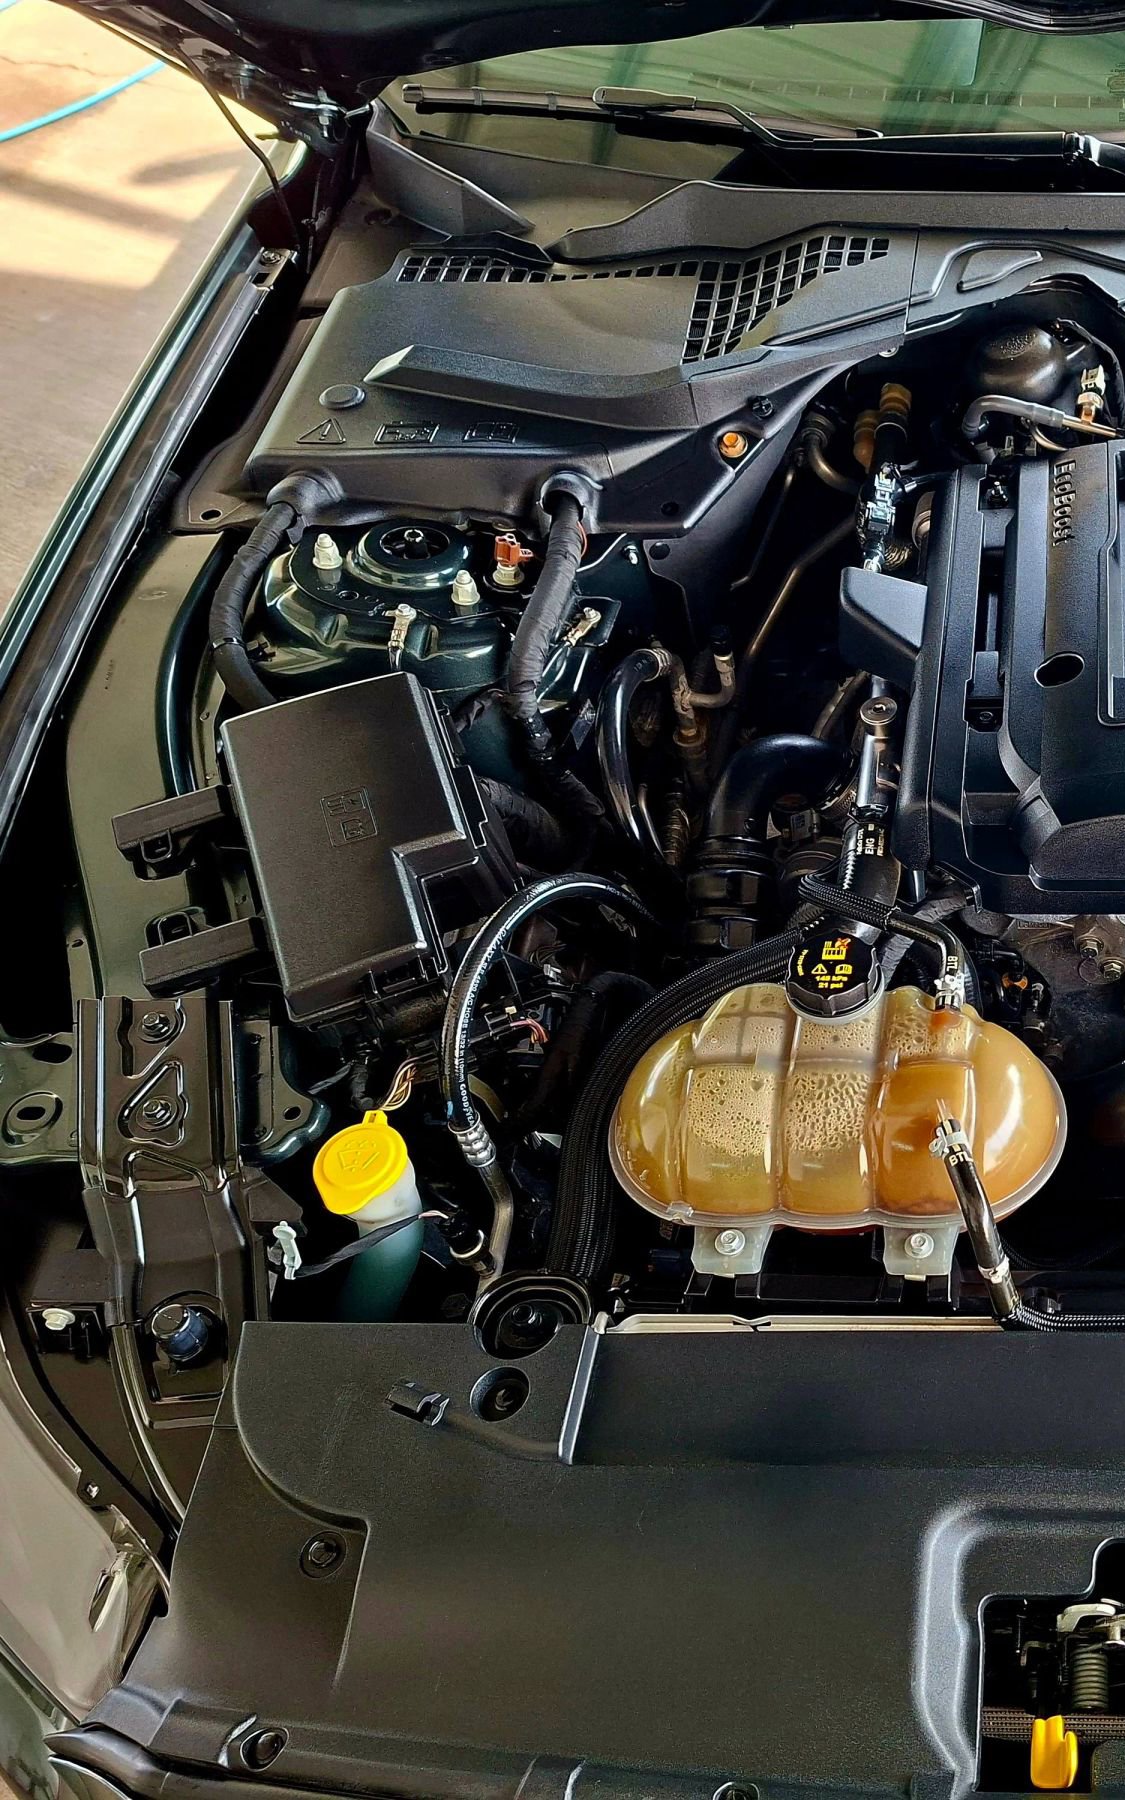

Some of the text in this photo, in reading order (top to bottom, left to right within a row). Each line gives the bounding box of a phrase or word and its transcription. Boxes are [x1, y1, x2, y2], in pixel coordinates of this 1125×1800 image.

[1053, 459, 1077, 547] EcoBoost
[864, 837, 876, 855] ENG
[947, 955, 959, 971] BTL
[463, 1008, 472, 1029] HOSE
[460, 1084, 475, 1127] GOODYEA
[949, 1151, 974, 1167] BTL
